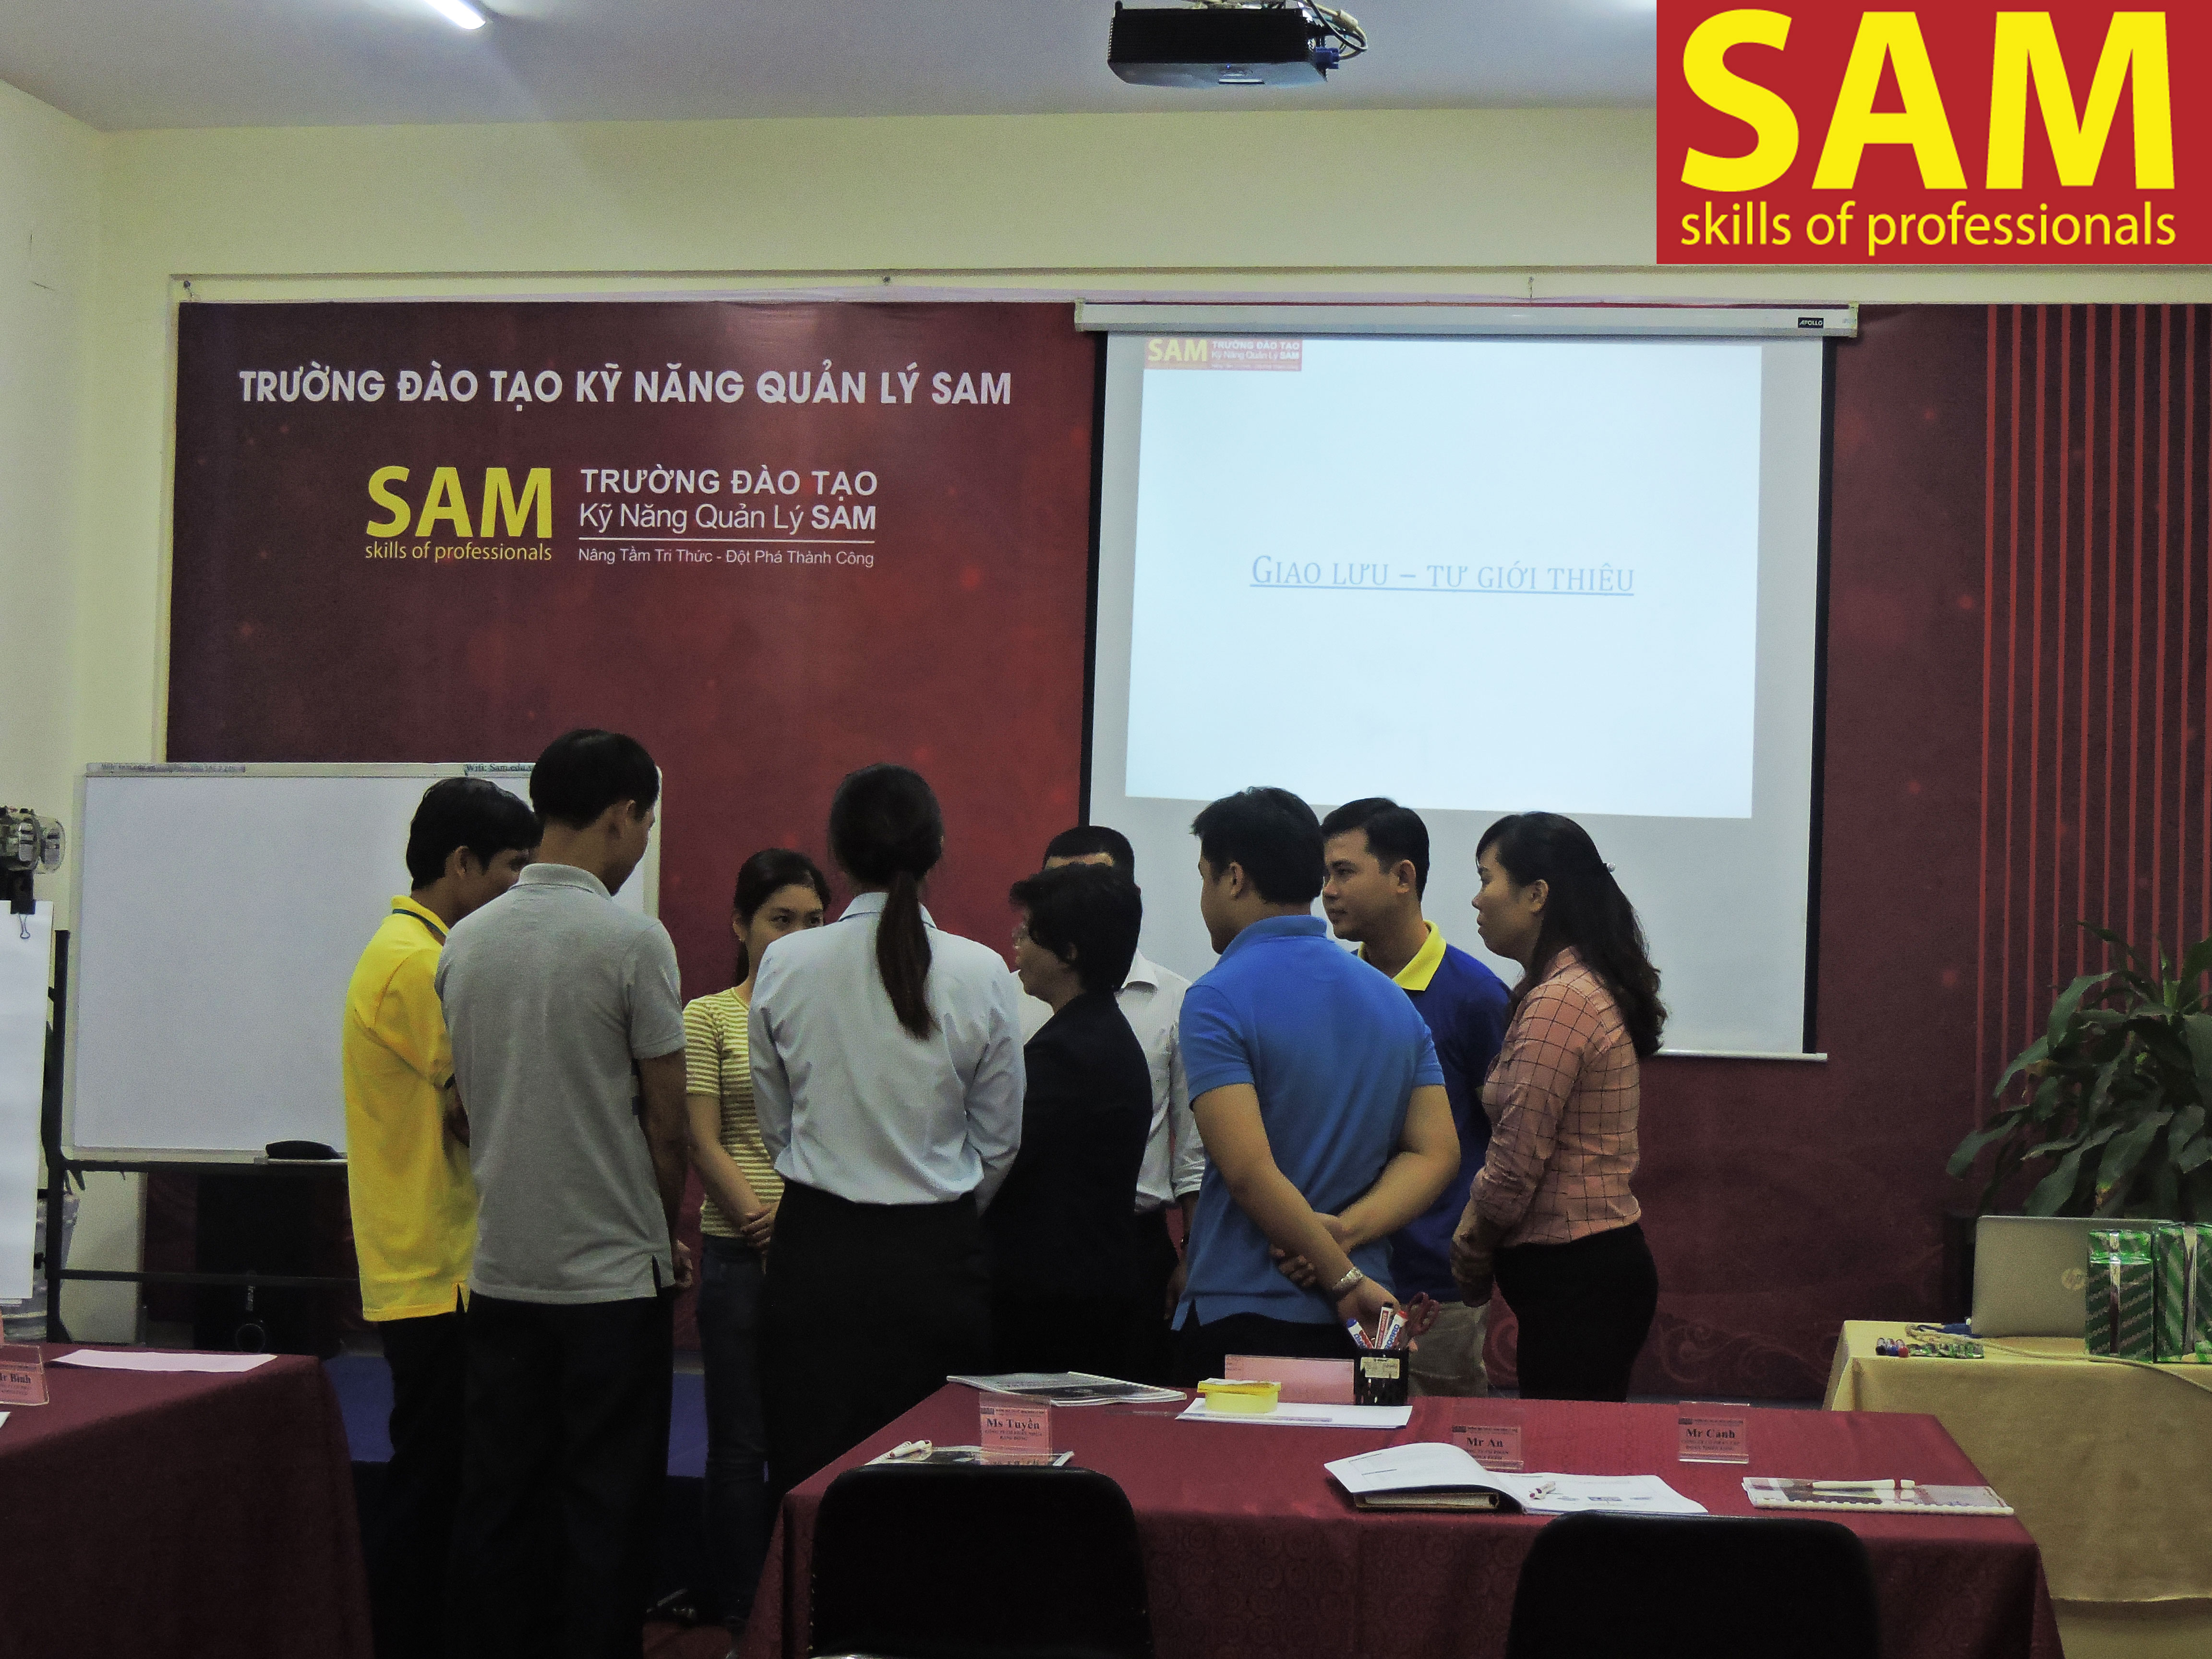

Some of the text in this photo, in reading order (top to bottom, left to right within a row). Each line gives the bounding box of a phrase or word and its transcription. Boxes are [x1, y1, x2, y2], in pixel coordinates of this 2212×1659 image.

[1148, 339, 1207, 361] SAM
[240, 359, 1011, 411] TRƯỜNG ĐÀO TẠO KỸ NĂNG QUẢN LÝ SAM
[580, 464, 878, 501] TRƯỜNG ĐÀO TẠO
[366, 466, 553, 538] SAM
[580, 503, 876, 535] Kỹ Năng Quản Lý SAM
[365, 541, 553, 564] skills of professionals
[579, 548, 615, 565] Nâng
[620, 546, 650, 562] Tầm
[676, 549, 712, 563] Thức
[726, 550, 750, 565] Đột
[755, 550, 782, 563] Phá
[787, 550, 831, 564] Thành
[836, 552, 874, 567] Công
[1333, 562, 1389, 585] LƯU
[1478, 561, 1537, 590] GIỚI
[987, 1418, 1003, 1427] Ms
[1686, 1429, 1702, 1438] Mr
[1467, 1437, 1484, 1446] Mr
